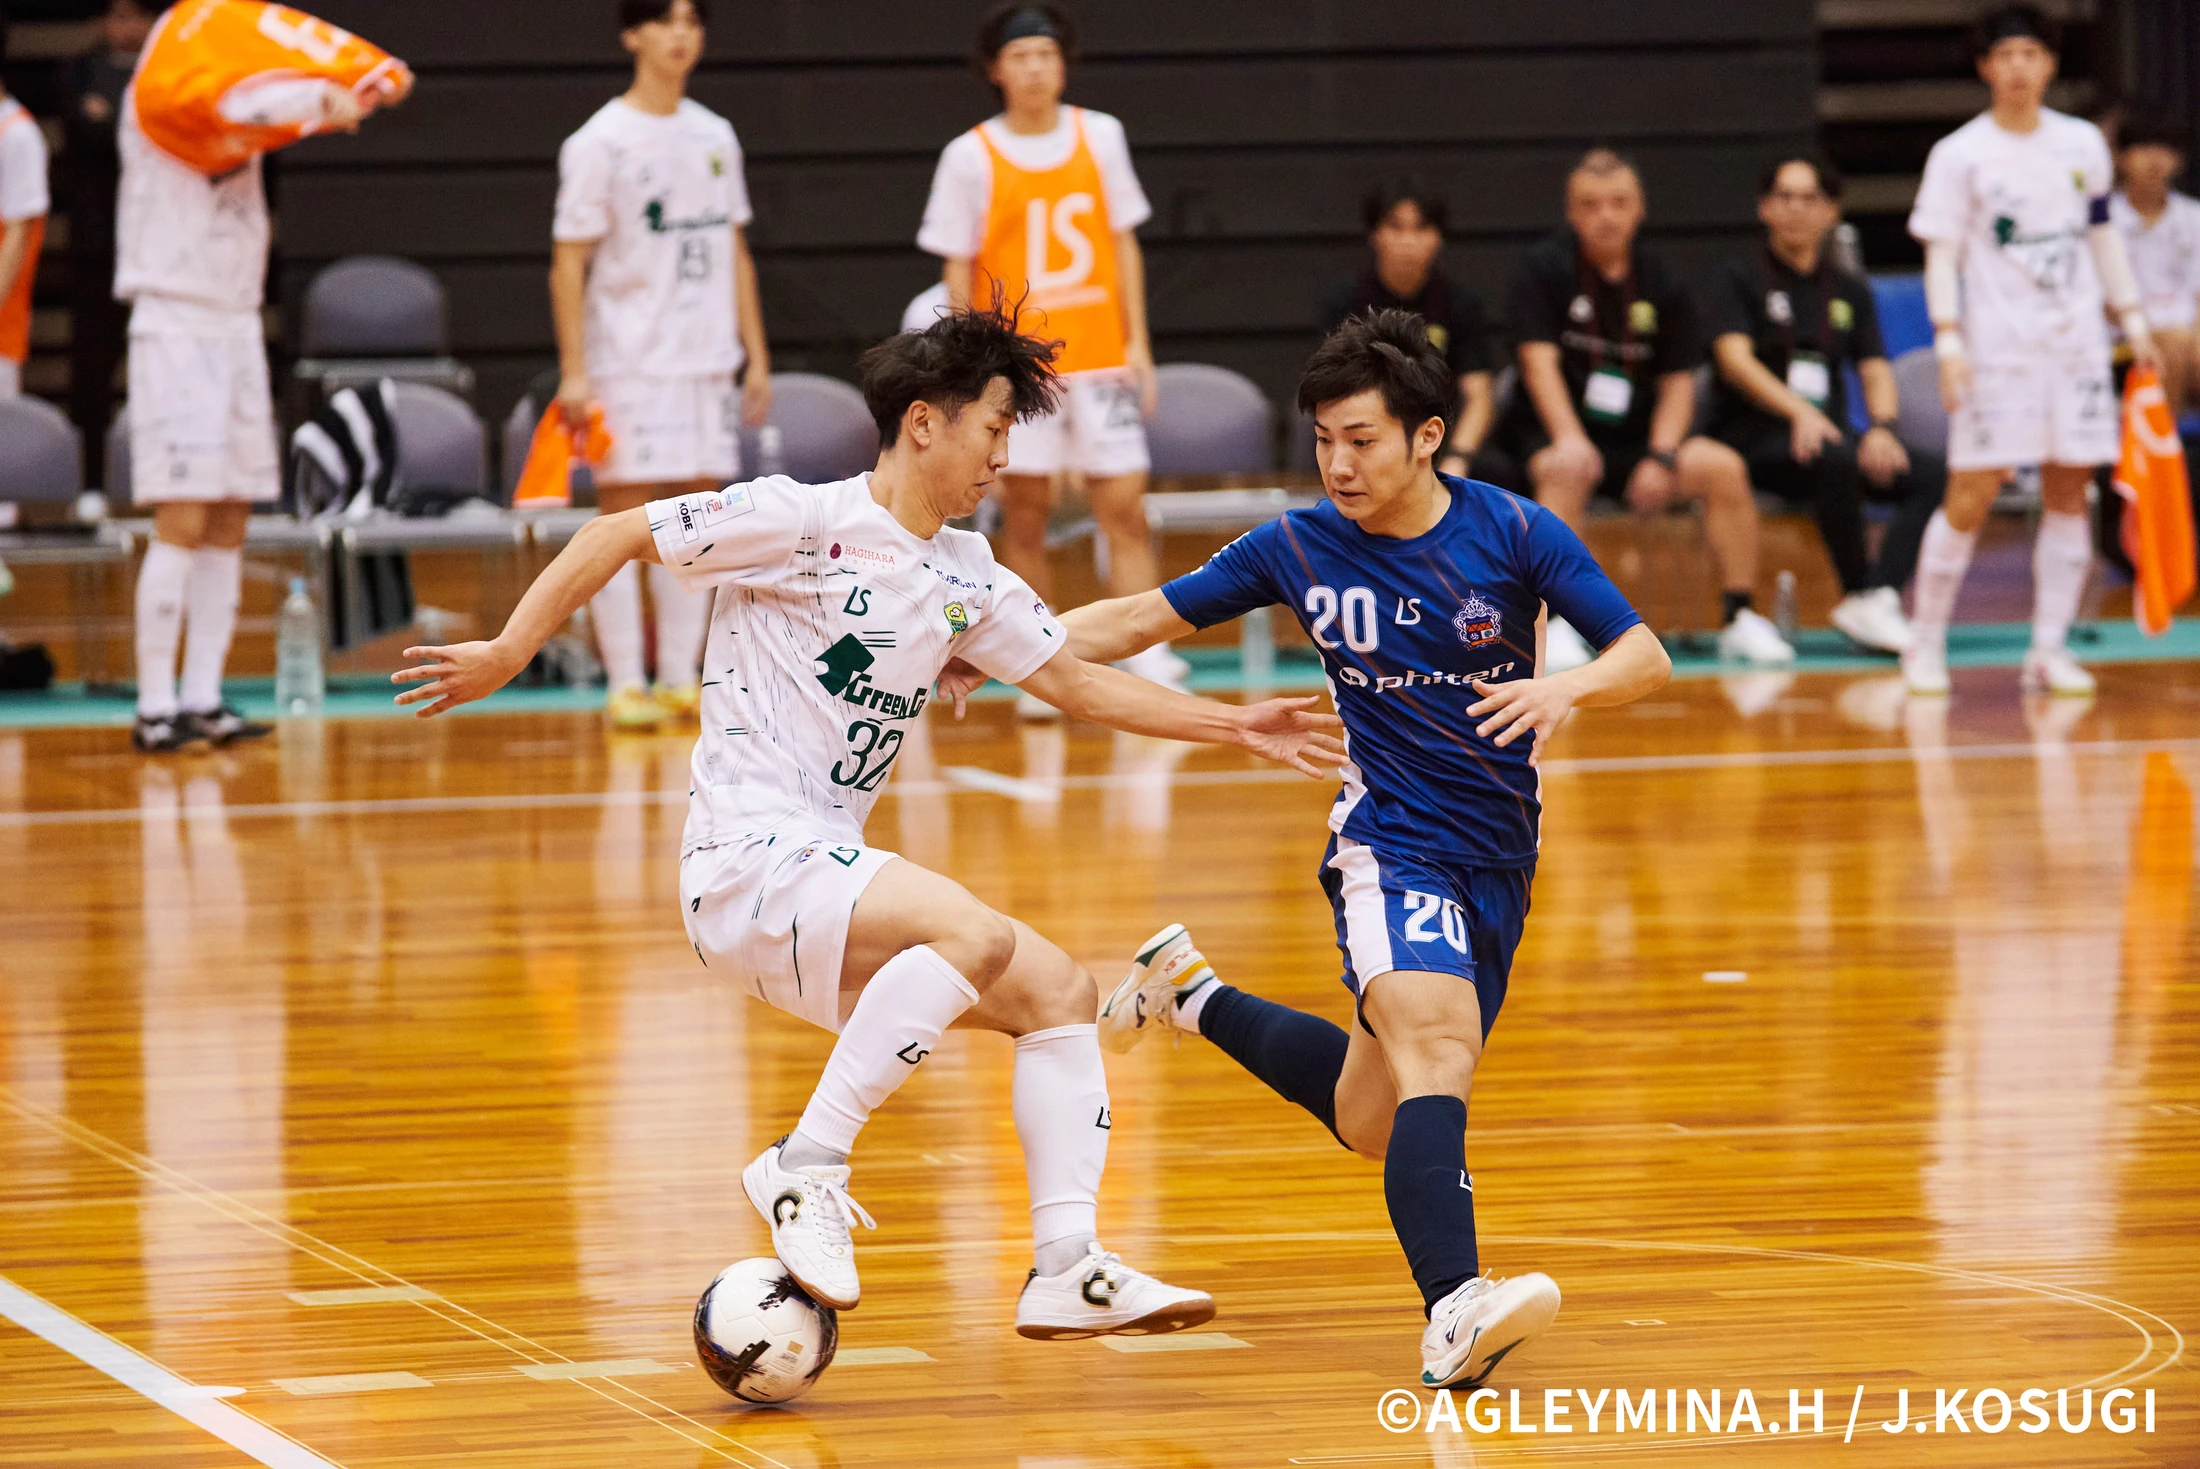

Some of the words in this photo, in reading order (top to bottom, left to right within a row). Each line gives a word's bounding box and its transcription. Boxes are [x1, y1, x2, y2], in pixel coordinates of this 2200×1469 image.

[1026, 192, 1095, 291] LS
[678, 501, 694, 532] KOBE
[845, 545, 896, 565] HAGIHARA
[842, 585, 872, 617] LS
[1394, 596, 1421, 626] LS
[1304, 584, 1380, 654] 20
[1375, 661, 1515, 694] phiten
[830, 720, 904, 792] 32
[827, 846, 860, 867] LS
[1403, 889, 1468, 955] 20
[896, 1041, 930, 1065] LS
